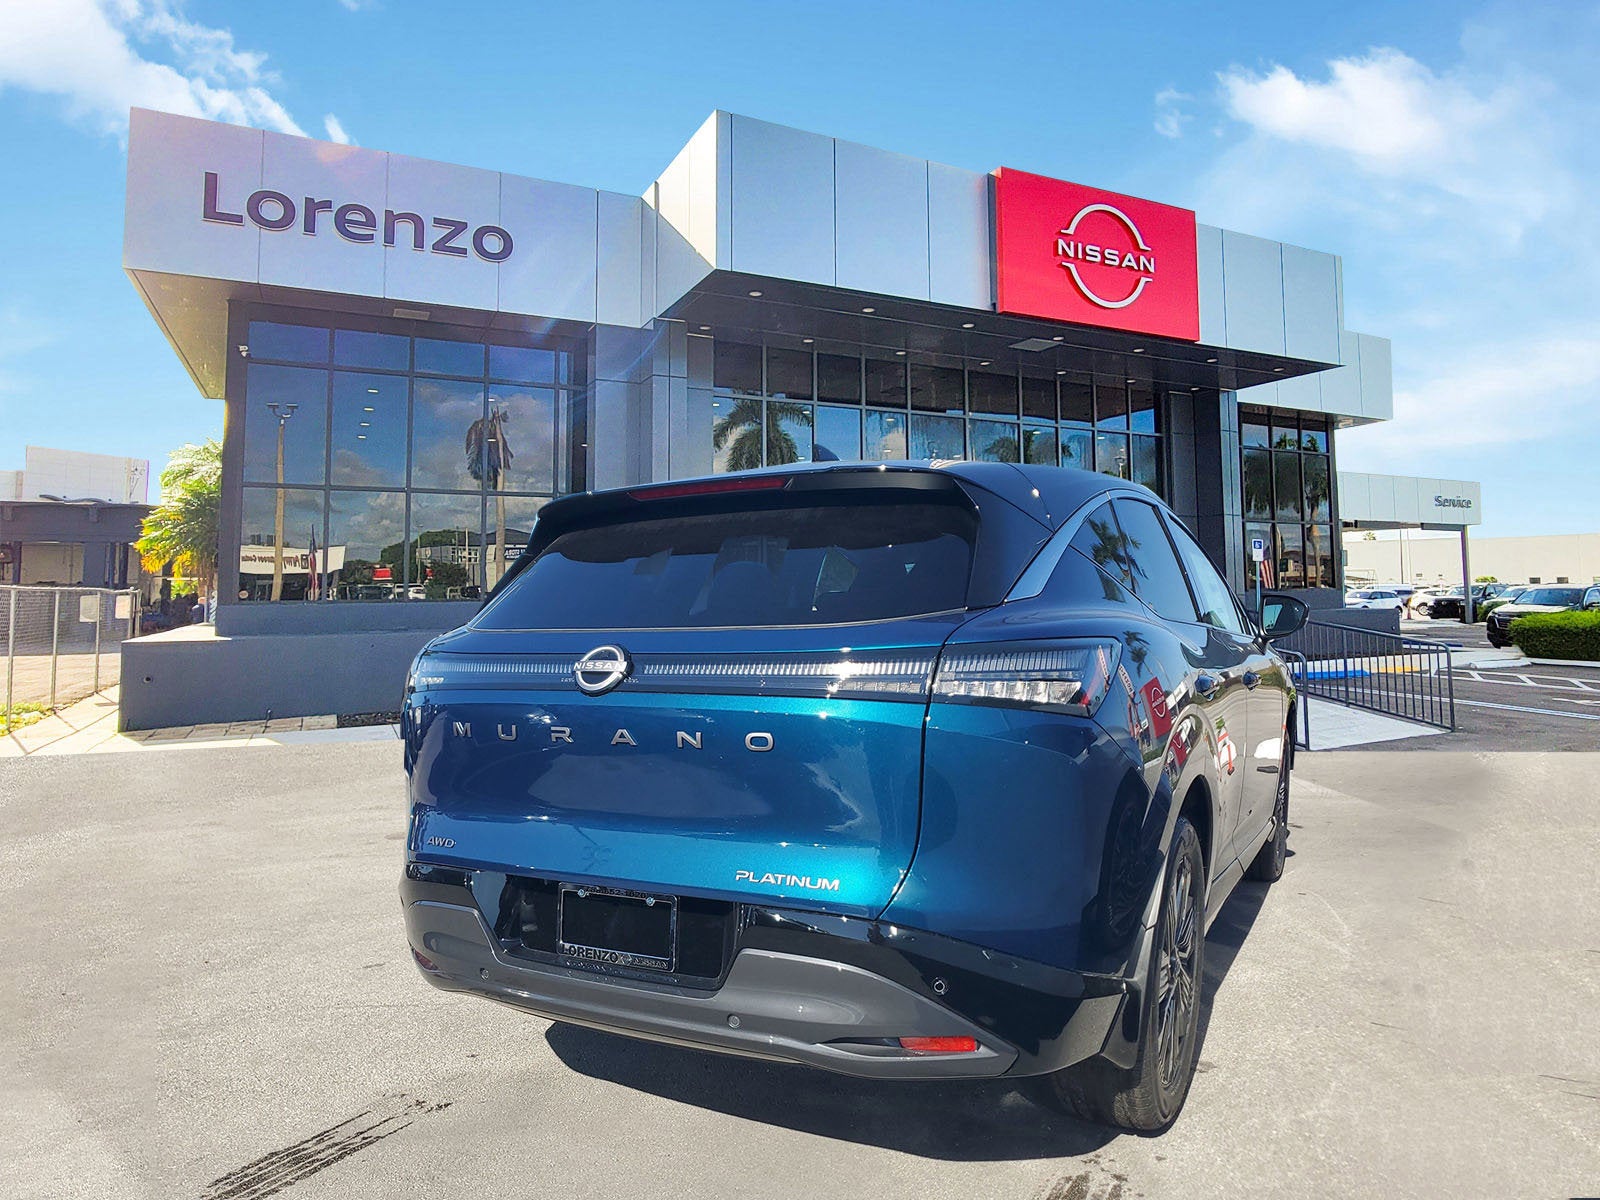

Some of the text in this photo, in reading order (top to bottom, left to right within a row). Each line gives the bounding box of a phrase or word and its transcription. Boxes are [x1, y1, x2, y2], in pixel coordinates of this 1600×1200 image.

[202, 170, 514, 263] Lorenzo
[1057, 238, 1155, 273] NISSAN
[1434, 495, 1472, 509] Service
[573, 661, 627, 672] NISSAN
[451, 721, 775, 752] MURANO
[427, 836, 455, 848] AWD
[735, 870, 840, 891] PLATINUM
[562, 944, 619, 963] LORENZO
